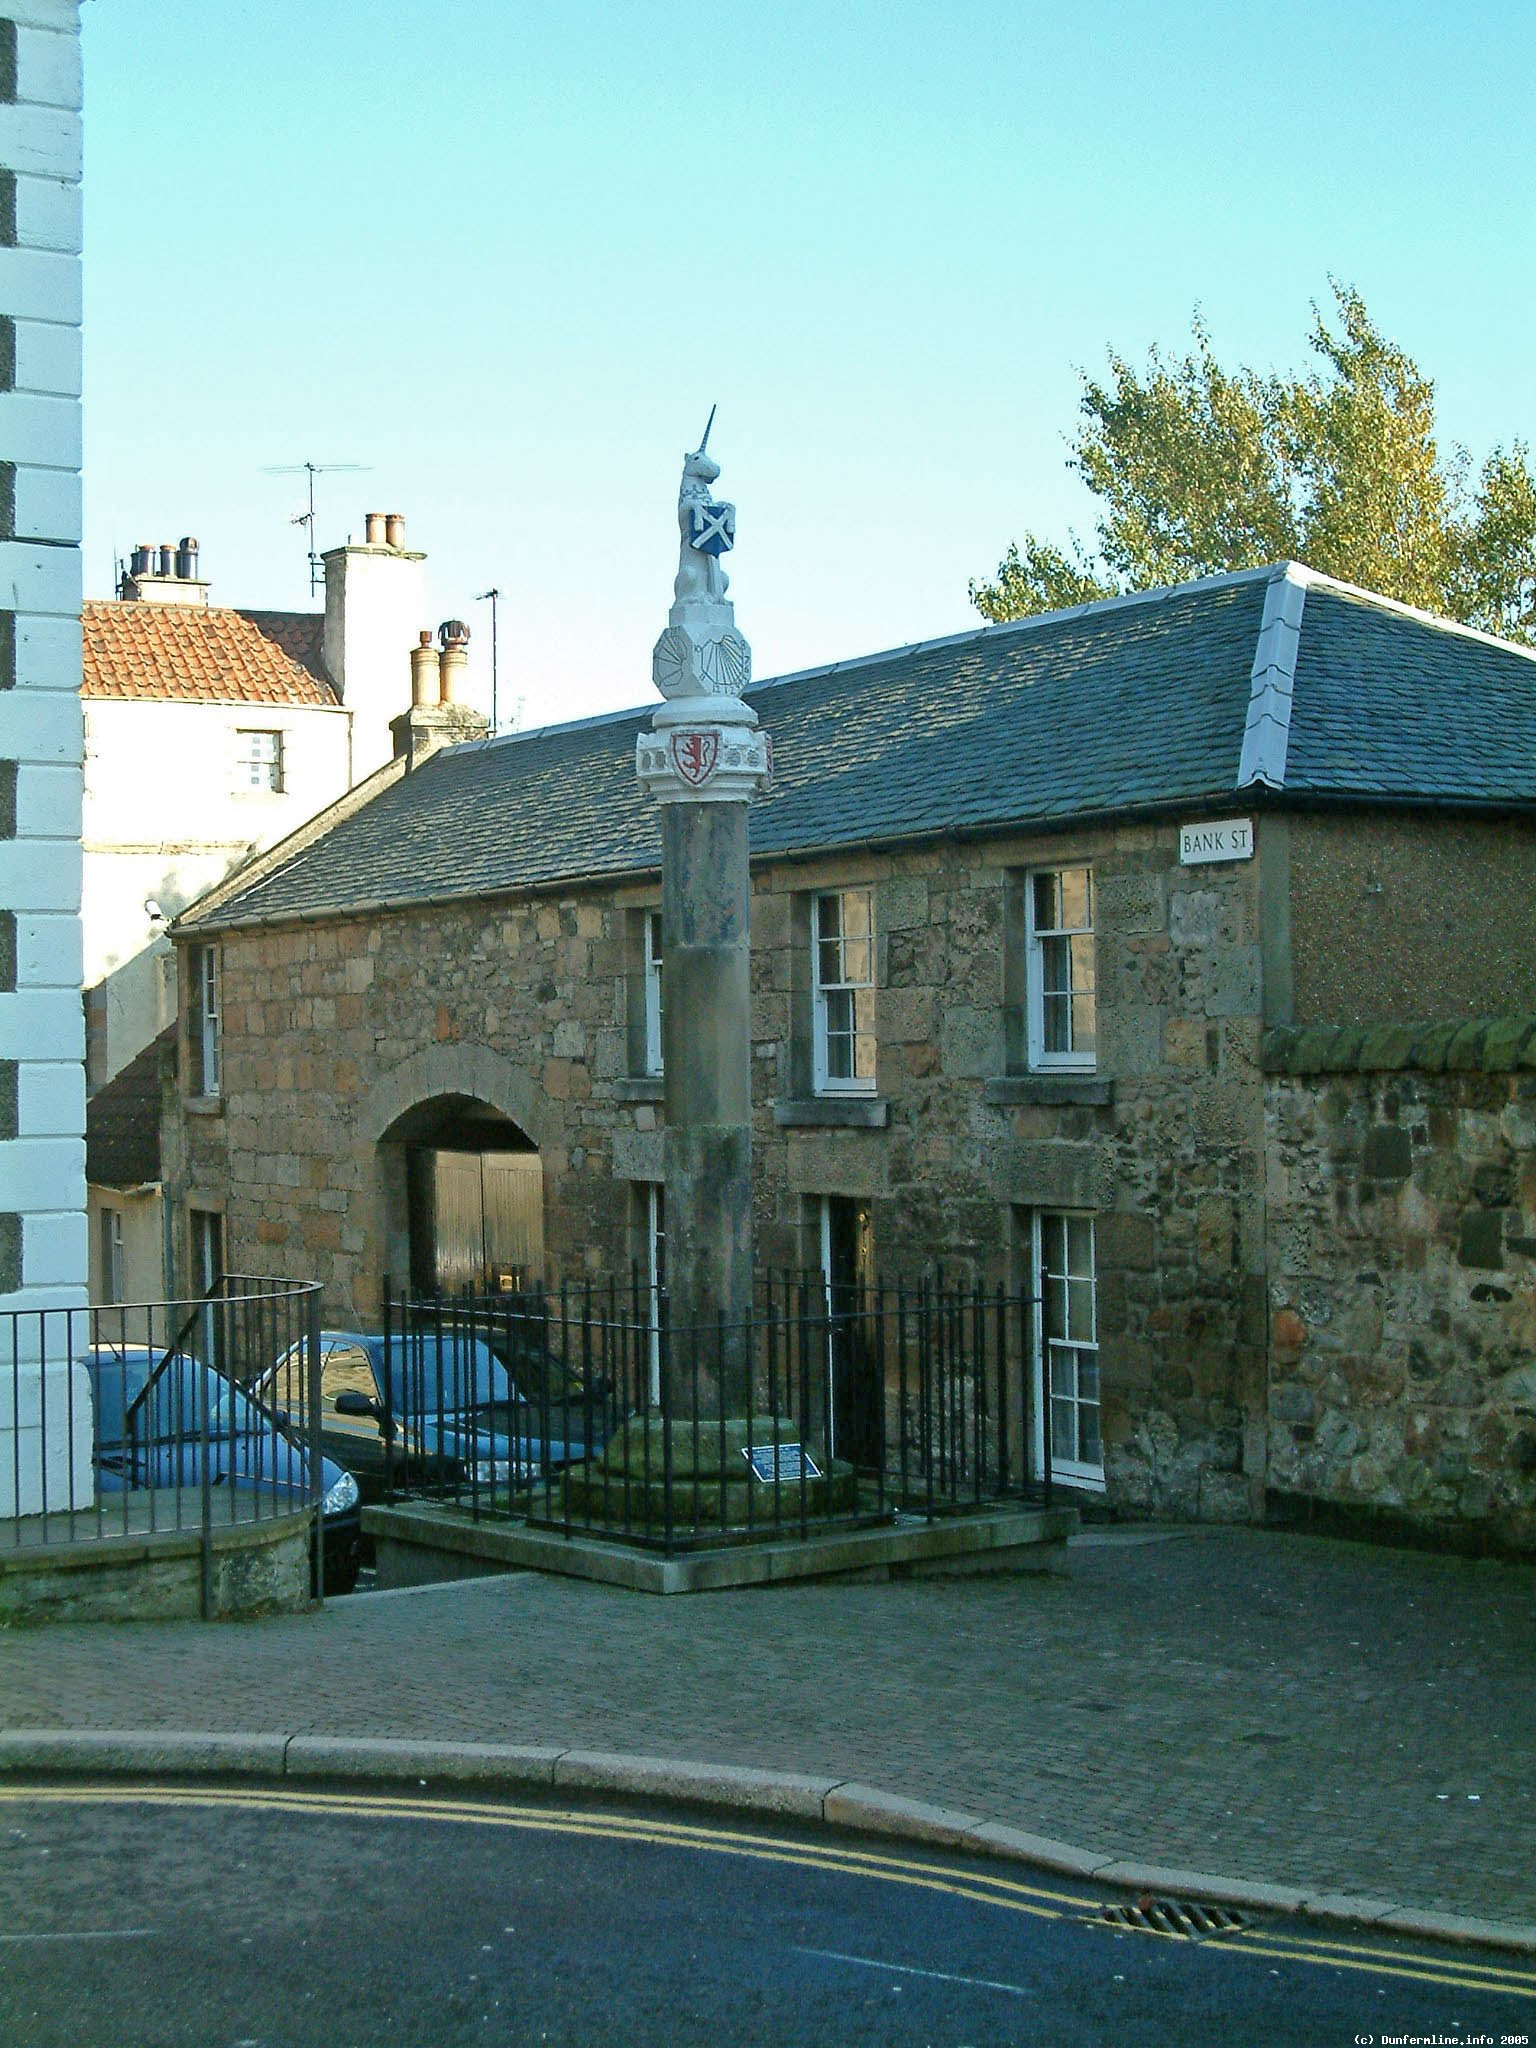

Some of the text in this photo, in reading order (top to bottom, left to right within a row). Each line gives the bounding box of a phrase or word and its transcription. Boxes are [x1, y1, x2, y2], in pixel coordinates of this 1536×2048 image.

[712, 685, 721, 693] 12
[1184, 830, 1248, 853] BANK ST
